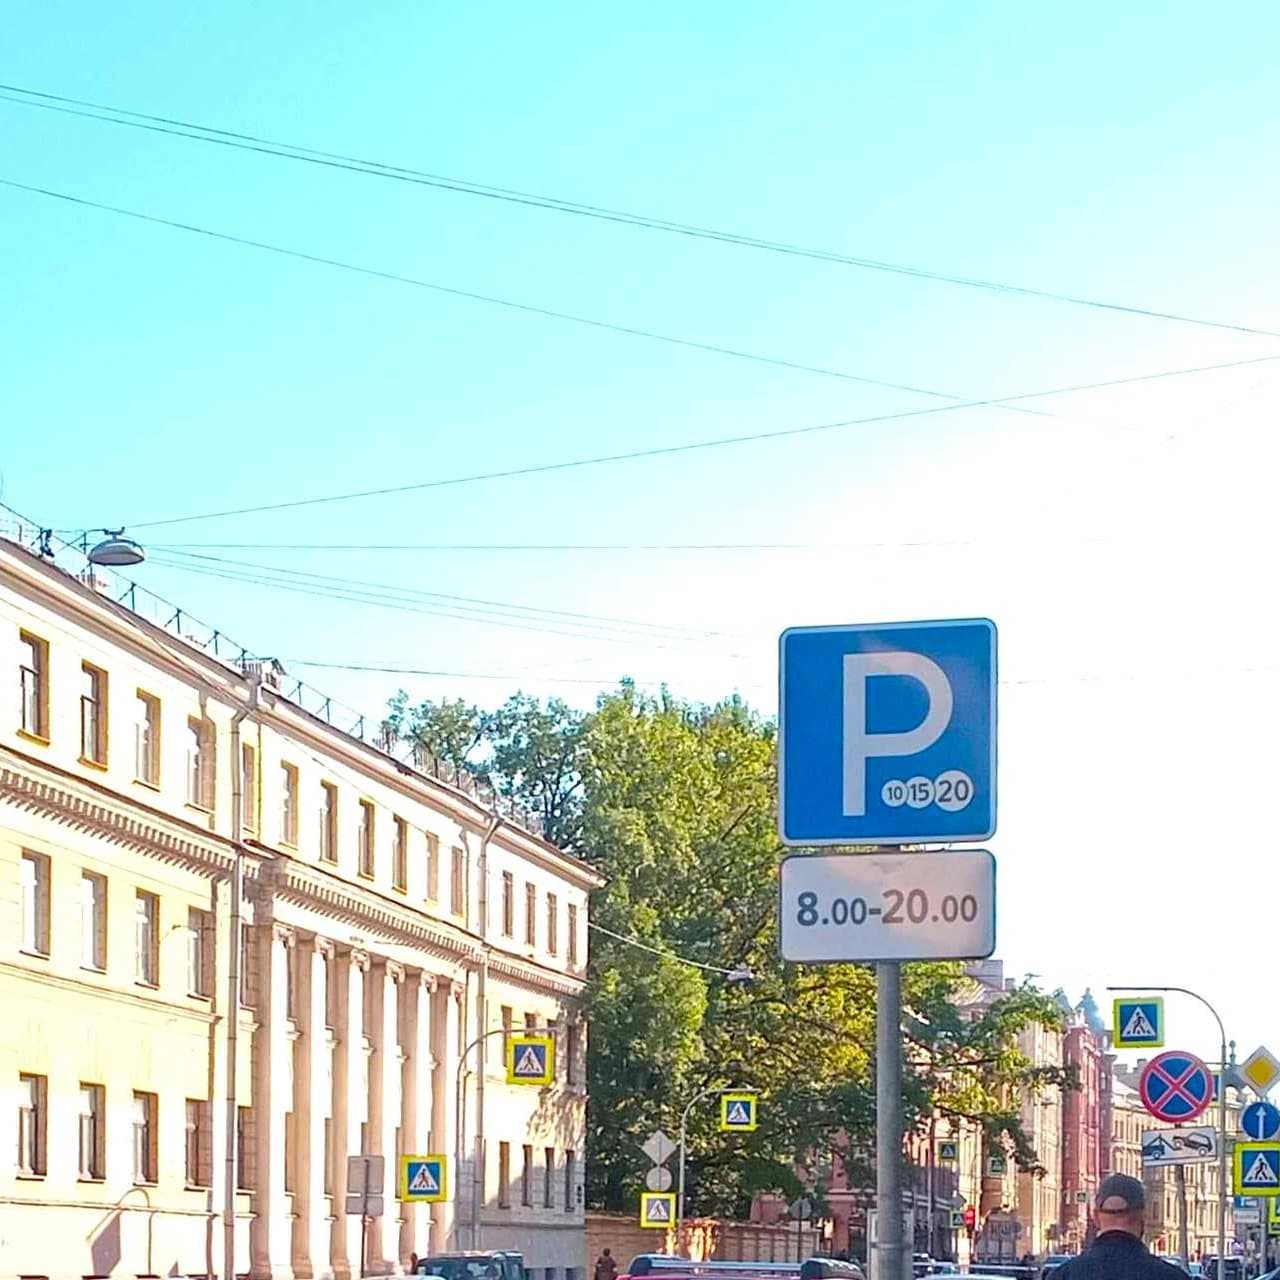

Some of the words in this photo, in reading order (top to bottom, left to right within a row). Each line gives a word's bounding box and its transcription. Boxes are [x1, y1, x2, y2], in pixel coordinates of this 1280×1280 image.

[842, 651, 954, 817] P
[887, 786, 903, 801] 10
[910, 783, 930, 802] 15
[938, 779, 969, 802] 20
[796, 889, 978, 927] 8.00-20.00
